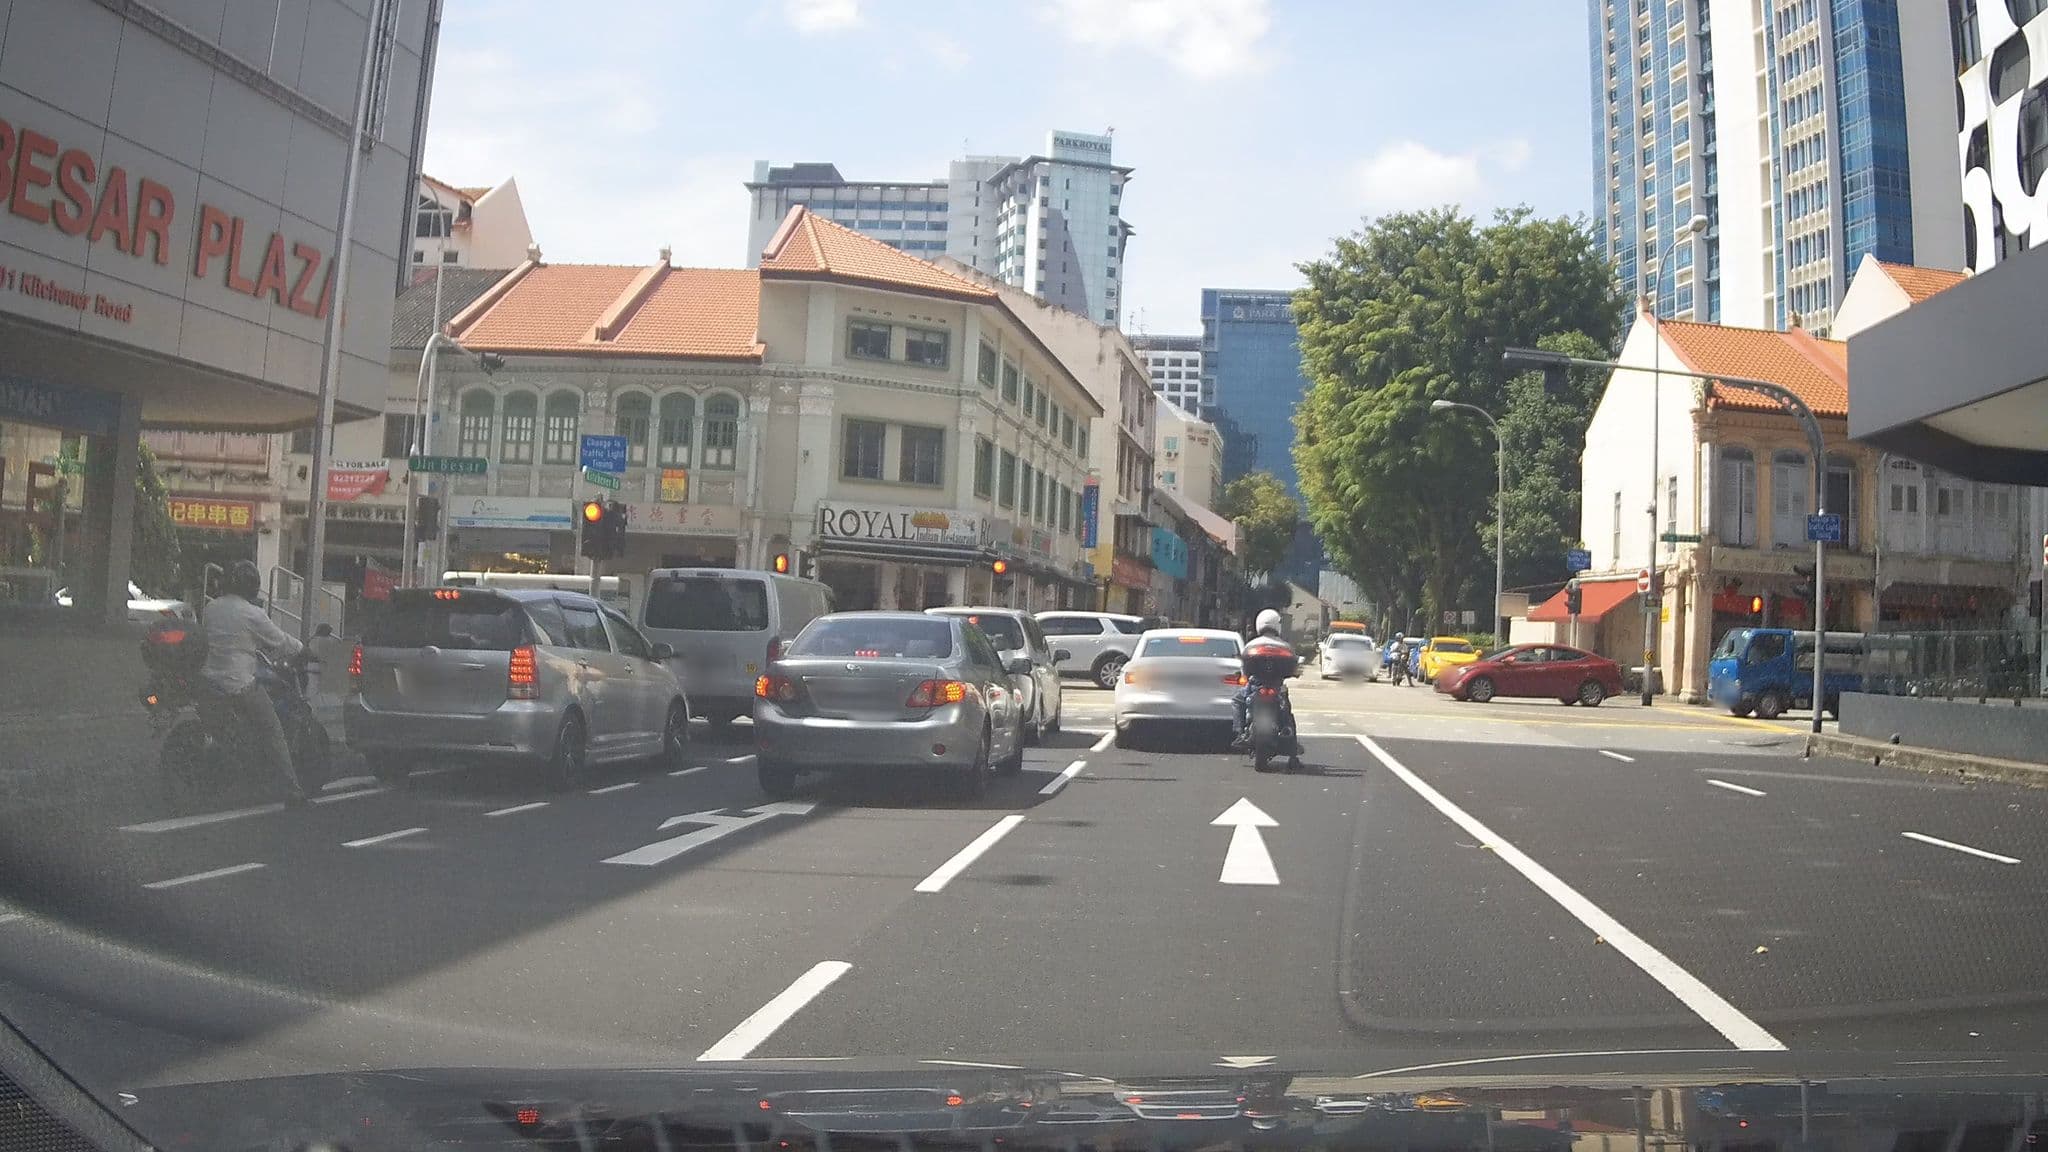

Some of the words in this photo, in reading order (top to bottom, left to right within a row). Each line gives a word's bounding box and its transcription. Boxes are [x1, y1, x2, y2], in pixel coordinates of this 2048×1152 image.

[1053, 137, 1111, 153] PARKROYAL
[440, 460, 480, 472] Besar
[820, 507, 915, 541] ROYAL
